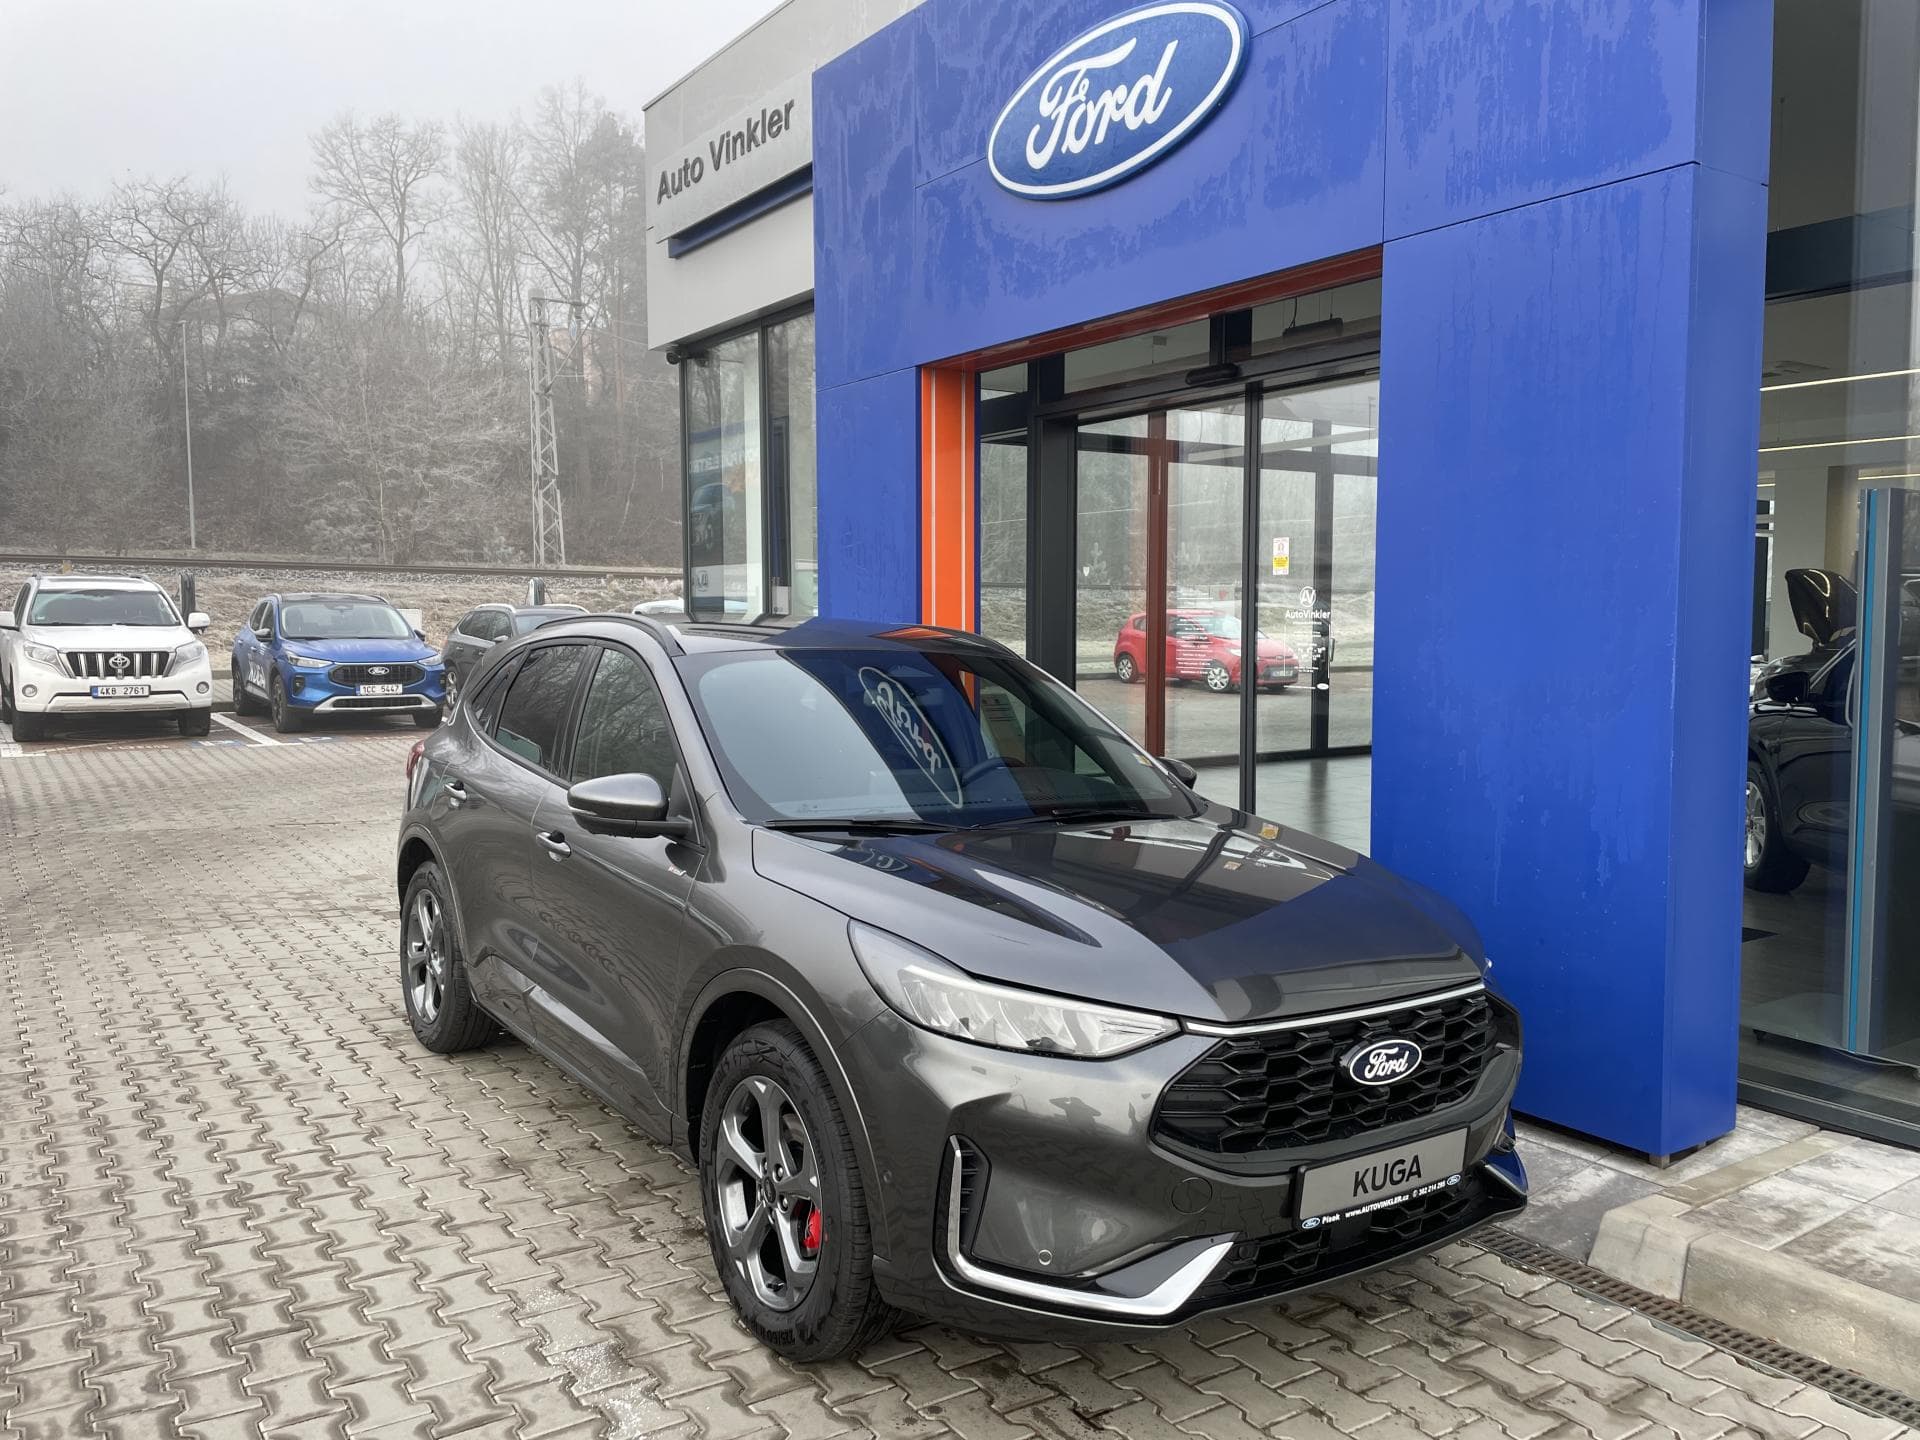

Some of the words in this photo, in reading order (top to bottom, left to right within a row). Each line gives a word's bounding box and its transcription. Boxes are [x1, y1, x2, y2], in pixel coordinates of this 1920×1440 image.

[1026, 37, 1178, 170] Ford
[657, 156, 704, 205] Auto
[709, 99, 794, 171] Vinkler
[1285, 609, 1331, 619] AutoVinkler
[123, 686, 145, 695] 2761
[1365, 1047, 1410, 1079] Ford
[1353, 1154, 1422, 1197] KUGA
